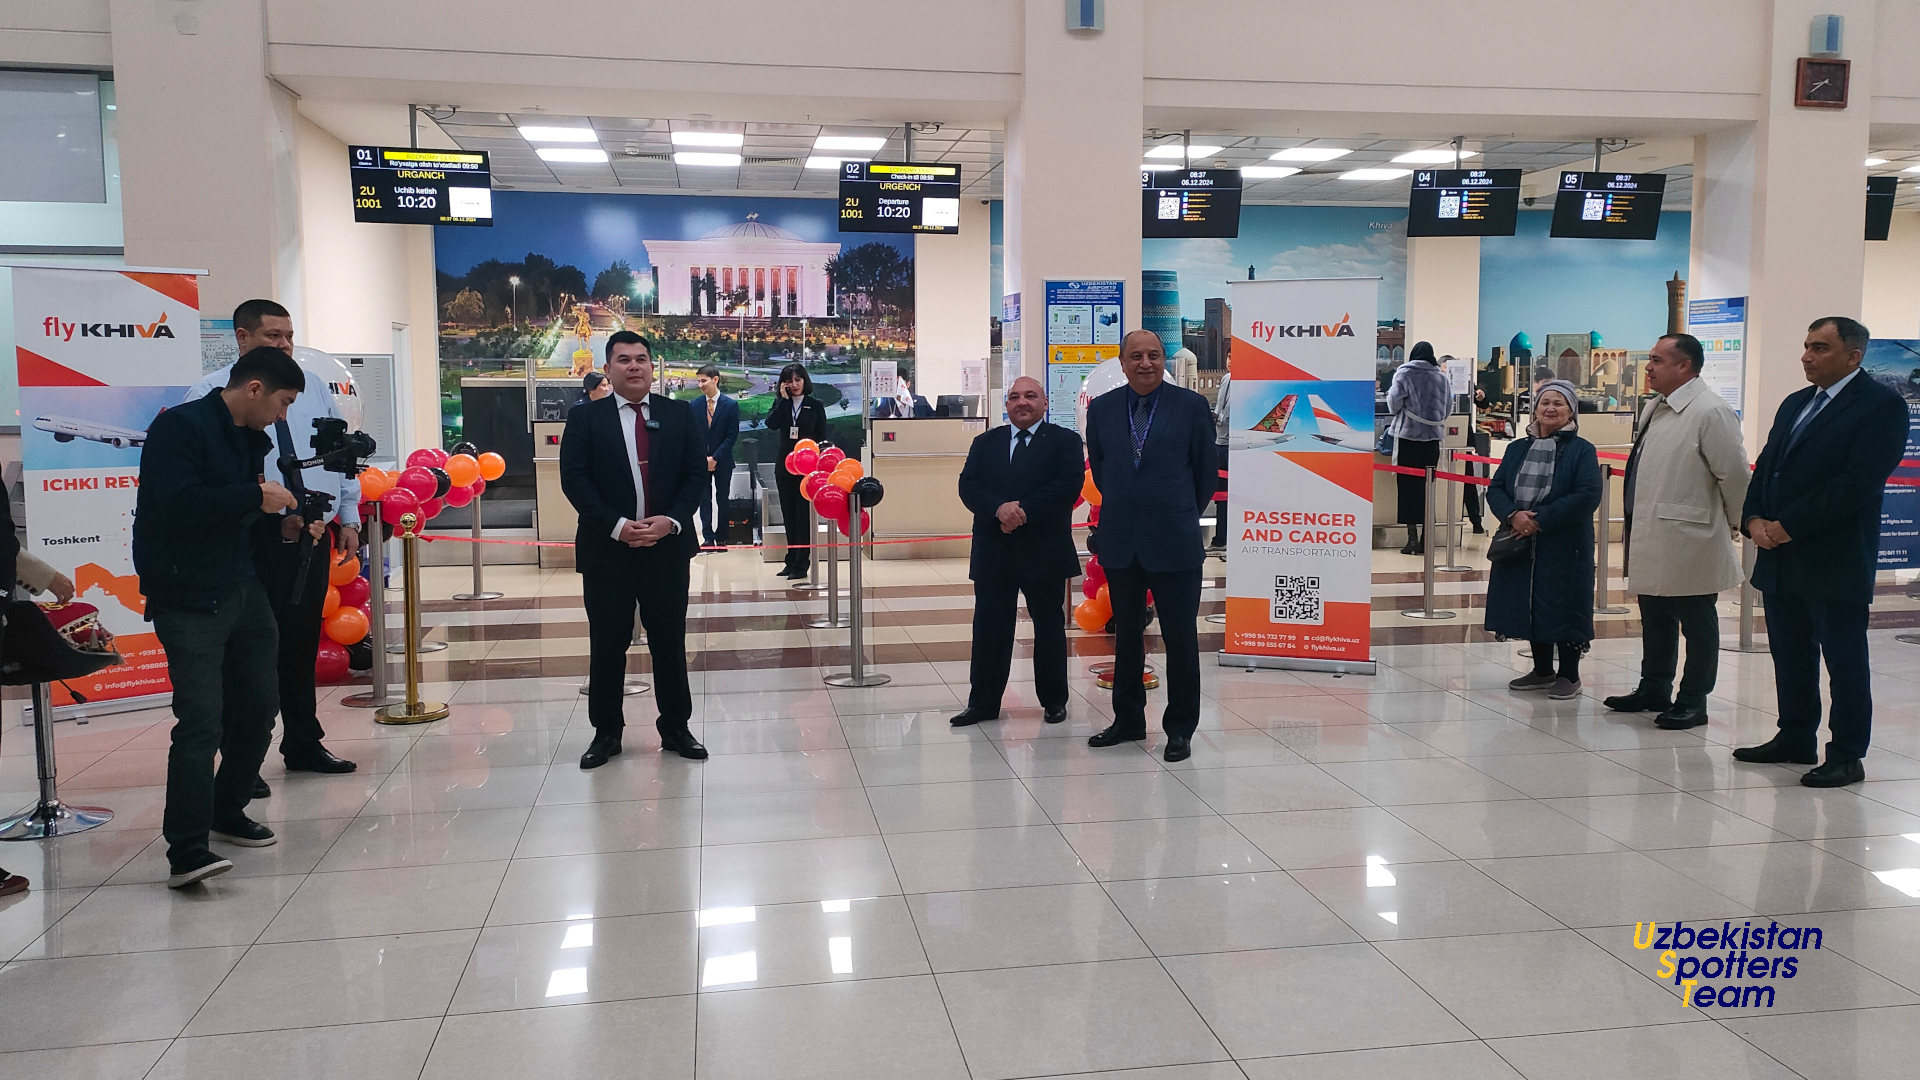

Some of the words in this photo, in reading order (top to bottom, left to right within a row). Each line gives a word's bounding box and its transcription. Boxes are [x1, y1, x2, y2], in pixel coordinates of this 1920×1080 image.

[356, 149, 373, 160] 01
[846, 164, 859, 174] 02
[397, 170, 445, 180] URGANCH
[1418, 172, 1431, 182] 04
[1565, 174, 1577, 184] 05
[360, 186, 375, 196] 2U
[394, 186, 415, 194] Uchib
[416, 186, 437, 195] ketish
[879, 183, 921, 191] URGENCH
[356, 198, 382, 209] 1001
[398, 196, 436, 209] 10:20
[845, 198, 859, 207] 2U
[841, 209, 863, 219] 1001
[877, 206, 911, 218] 10:20
[1368, 221, 1393, 230] Khiva
[43, 316, 76, 342] fly
[80, 313, 175, 338] KHIVA
[1252, 321, 1276, 342] fly
[1280, 314, 1355, 338] KHIVA
[1080, 392, 1093, 409] fly
[302, 458, 324, 467] RONIN
[43, 478, 98, 491] ICHKI
[1244, 510, 1356, 528] PASSENGER
[42, 535, 101, 546] Toshkent
[1242, 529, 1283, 542] AND
[1289, 530, 1357, 545] CARGO
[1242, 546, 1259, 554] AIR
[1261, 547, 1356, 558] TRANSPORTATION
[1311, 634, 1360, 644] cd@flykhiva.uz
[109, 665, 135, 674] uchun:
[105, 678, 165, 690] info@flykhiva.uz
